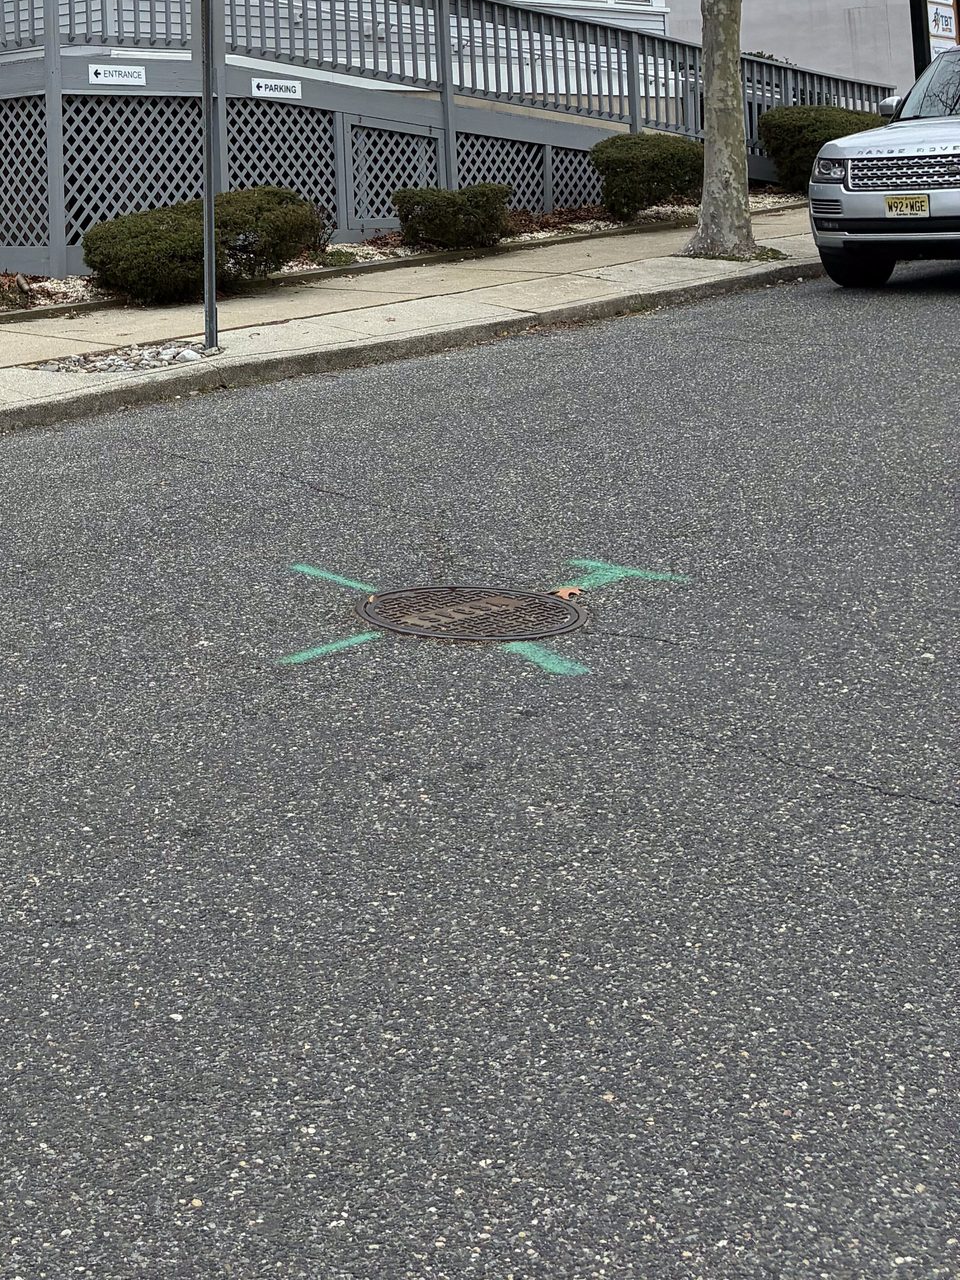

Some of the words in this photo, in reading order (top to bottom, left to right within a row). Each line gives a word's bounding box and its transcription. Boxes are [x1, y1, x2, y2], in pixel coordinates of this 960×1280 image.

[940, 15, 952, 27] TBT
[103, 70, 142, 79] ENTRANCE
[264, 84, 296, 94] PARKING
[916, 145, 960, 153] ROVE
